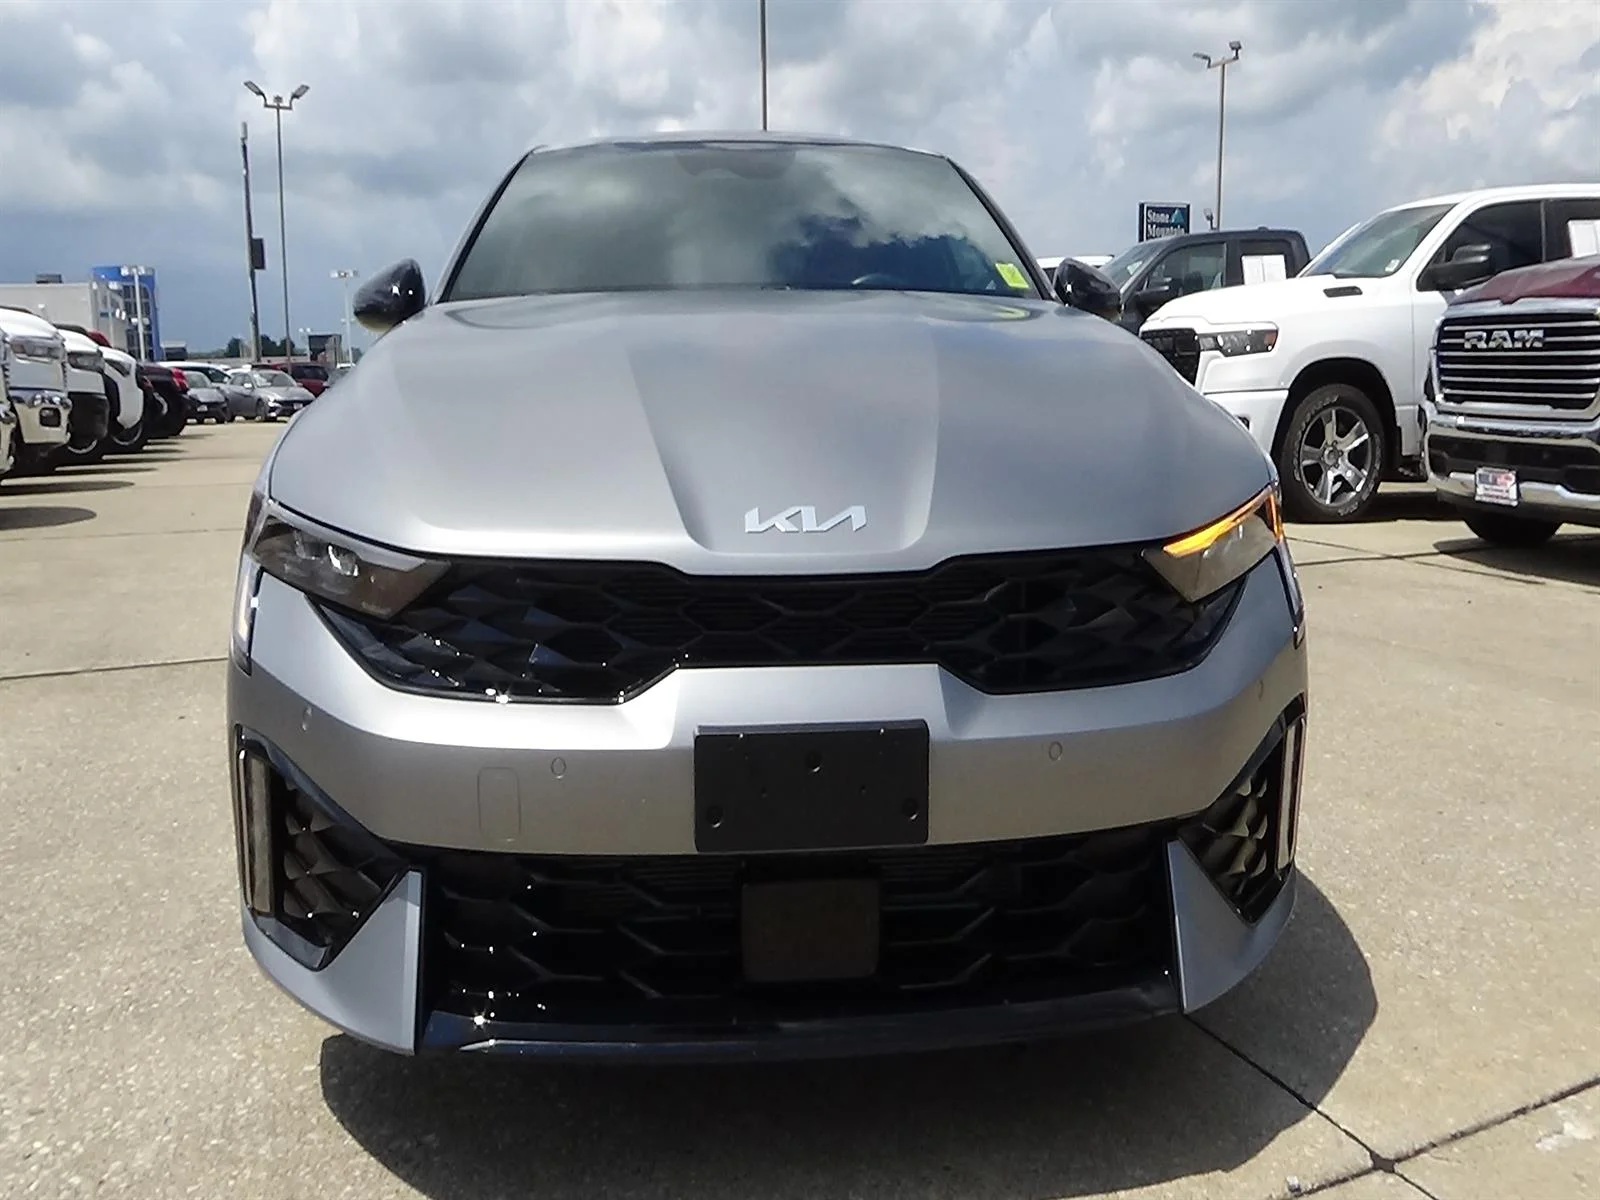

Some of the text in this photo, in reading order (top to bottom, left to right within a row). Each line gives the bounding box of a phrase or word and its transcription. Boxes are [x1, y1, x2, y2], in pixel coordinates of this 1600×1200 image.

[1147, 209, 1170, 223] Stone
[1147, 224, 1185, 238] Mountain
[1463, 329, 1545, 349] RAM
[744, 505, 867, 533] KIA
